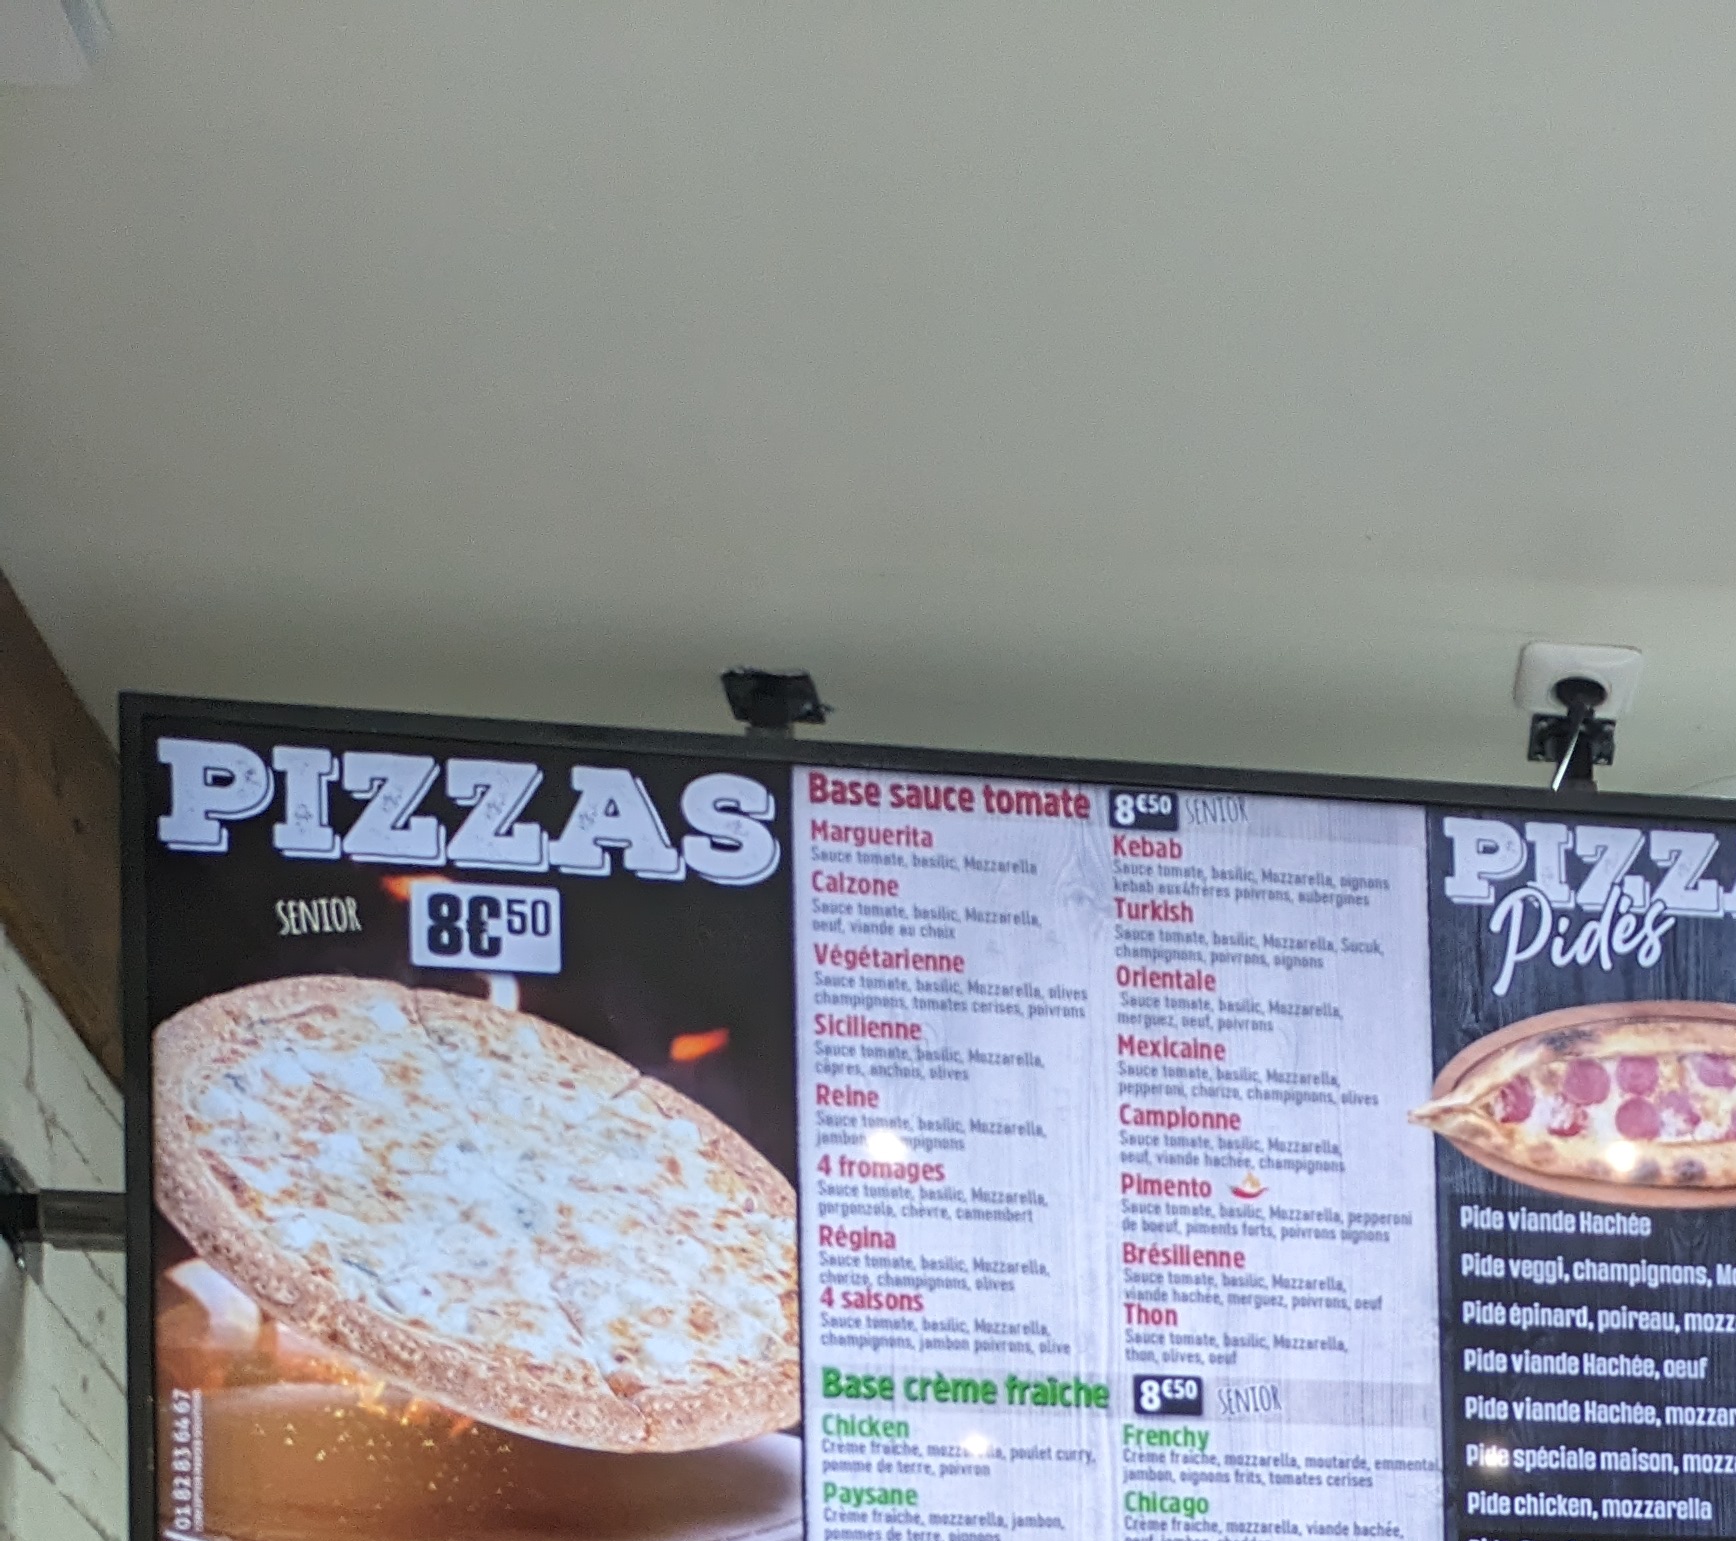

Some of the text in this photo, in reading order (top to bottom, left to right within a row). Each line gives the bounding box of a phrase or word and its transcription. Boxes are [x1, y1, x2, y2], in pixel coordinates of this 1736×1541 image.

[809, 771, 1091, 819] Base sauce tomate
[156, 737, 781, 885] PIZZAS
[1114, 793, 1172, 825] 8€50
[1185, 798, 1248, 824] SENIOR
[811, 820, 933, 849] Marguerita
[1113, 835, 1182, 860] Kebab
[812, 871, 899, 897] Calzone
[275, 897, 362, 936] SENIOR
[1114, 898, 1194, 924] Turkish
[426, 893, 552, 958] 8€50
[1490, 885, 1676, 997] Pidés
[814, 943, 965, 974] Végétarienne
[1116, 966, 1216, 992] Orientale
[814, 1014, 922, 1040] Sicilienne
[1118, 1035, 1226, 1062] Mexicaine
[816, 1084, 879, 1108] Reine
[1119, 1104, 1242, 1132] Campionne
[817, 1156, 945, 1184] 4 fromages
[1121, 1173, 1212, 1198] Pimento
[1461, 1206, 1652, 1237] Pide viande Hachée
[818, 1225, 896, 1251] Régina
[1123, 1242, 1246, 1269] Brésilienne
[1461, 1253, 1505, 1277] Pide
[1509, 1258, 1570, 1286] veggi,
[1573, 1260, 1713, 1288] champignons,
[820, 1287, 924, 1313] 4 saisons
[1124, 1303, 1178, 1327] Thon
[1510, 1302, 1594, 1332] épinard,
[1598, 1309, 1681, 1334] poireau,
[821, 1366, 1109, 1409] Base crème fraîche
[1140, 1379, 1198, 1411] 8€50
[1218, 1385, 1281, 1414] SENIOR
[821, 1414, 910, 1439] Chicken
[1123, 1425, 1209, 1451] Frenchy
[822, 1483, 918, 1508] Paysane
[1124, 1492, 1209, 1516] Chicago
[1467, 1492, 1712, 1521] Pide chicken, mozzarella
